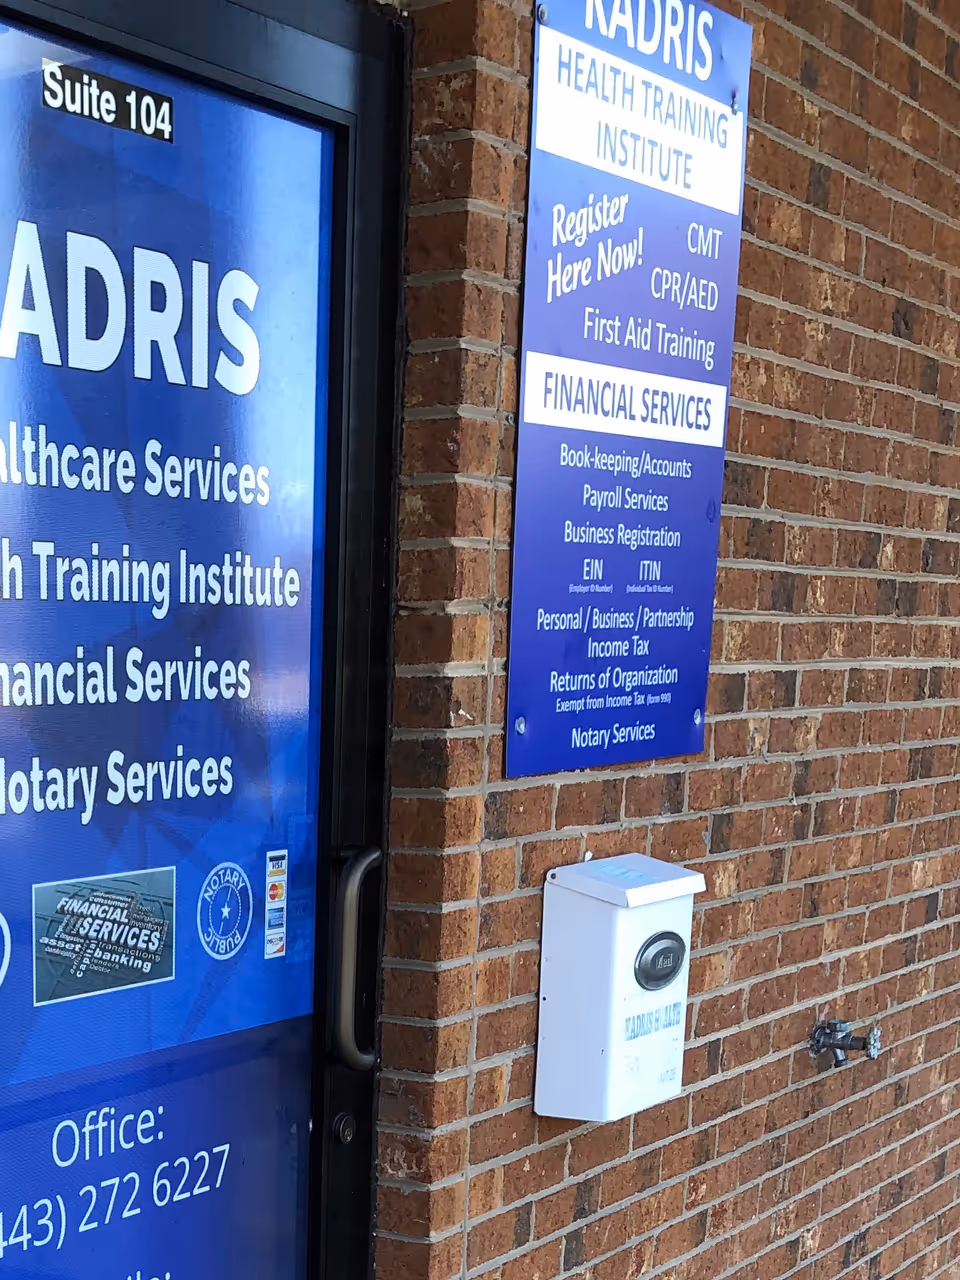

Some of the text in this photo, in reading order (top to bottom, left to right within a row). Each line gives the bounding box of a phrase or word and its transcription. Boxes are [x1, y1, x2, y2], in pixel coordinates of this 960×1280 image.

[42, 62, 172, 139] Suite 104
[557, 44, 728, 148] HEALTH TRAINING
[597, 120, 693, 189] INSTITUTE
[551, 193, 629, 247] Register
[687, 222, 723, 260] CMT
[546, 227, 644, 304] Here Now!
[651, 266, 719, 312] CPR/AED
[584, 306, 715, 370] First Aid Training
[543, 372, 712, 431] FINANCIAL SERVICES
[144, 438, 271, 506] Services
[560, 443, 692, 478] Book-keeping/Accounts
[583, 484, 669, 512] Payroll Services
[564, 520, 681, 550] Business Registration
[32, 540, 170, 620] Training
[178, 549, 301, 607] Institute
[583, 558, 661, 581] EIN ITIN
[537, 606, 582, 631] Personal
[592, 607, 634, 629] Business
[643, 606, 694, 631] Partnership
[588, 635, 649, 658] Income Tax
[125, 645, 252, 702] Services
[550, 664, 678, 693] Returns of Organization
[556, 697, 585, 714] Exempt
[586, 694, 605, 710] from
[605, 694, 632, 708] Income
[633, 692, 645, 705] Tax
[571, 720, 656, 750] Notary Services
[106, 745, 233, 805] Services
[271, 861, 283, 870] VISA
[204, 869, 245, 902] NOTARY
[56, 897, 130, 923] FINANCIAL
[79, 917, 161, 952] SERVICES
[204, 928, 241, 954] PUBLIC
[76, 940, 98, 977] capital
[94, 948, 152, 973] banking
[655, 1001, 681, 1032] HALTH
[51, 1105, 164, 1168] Office:
[78, 1172, 140, 1232] 272
[152, 1143, 231, 1208] 6227
